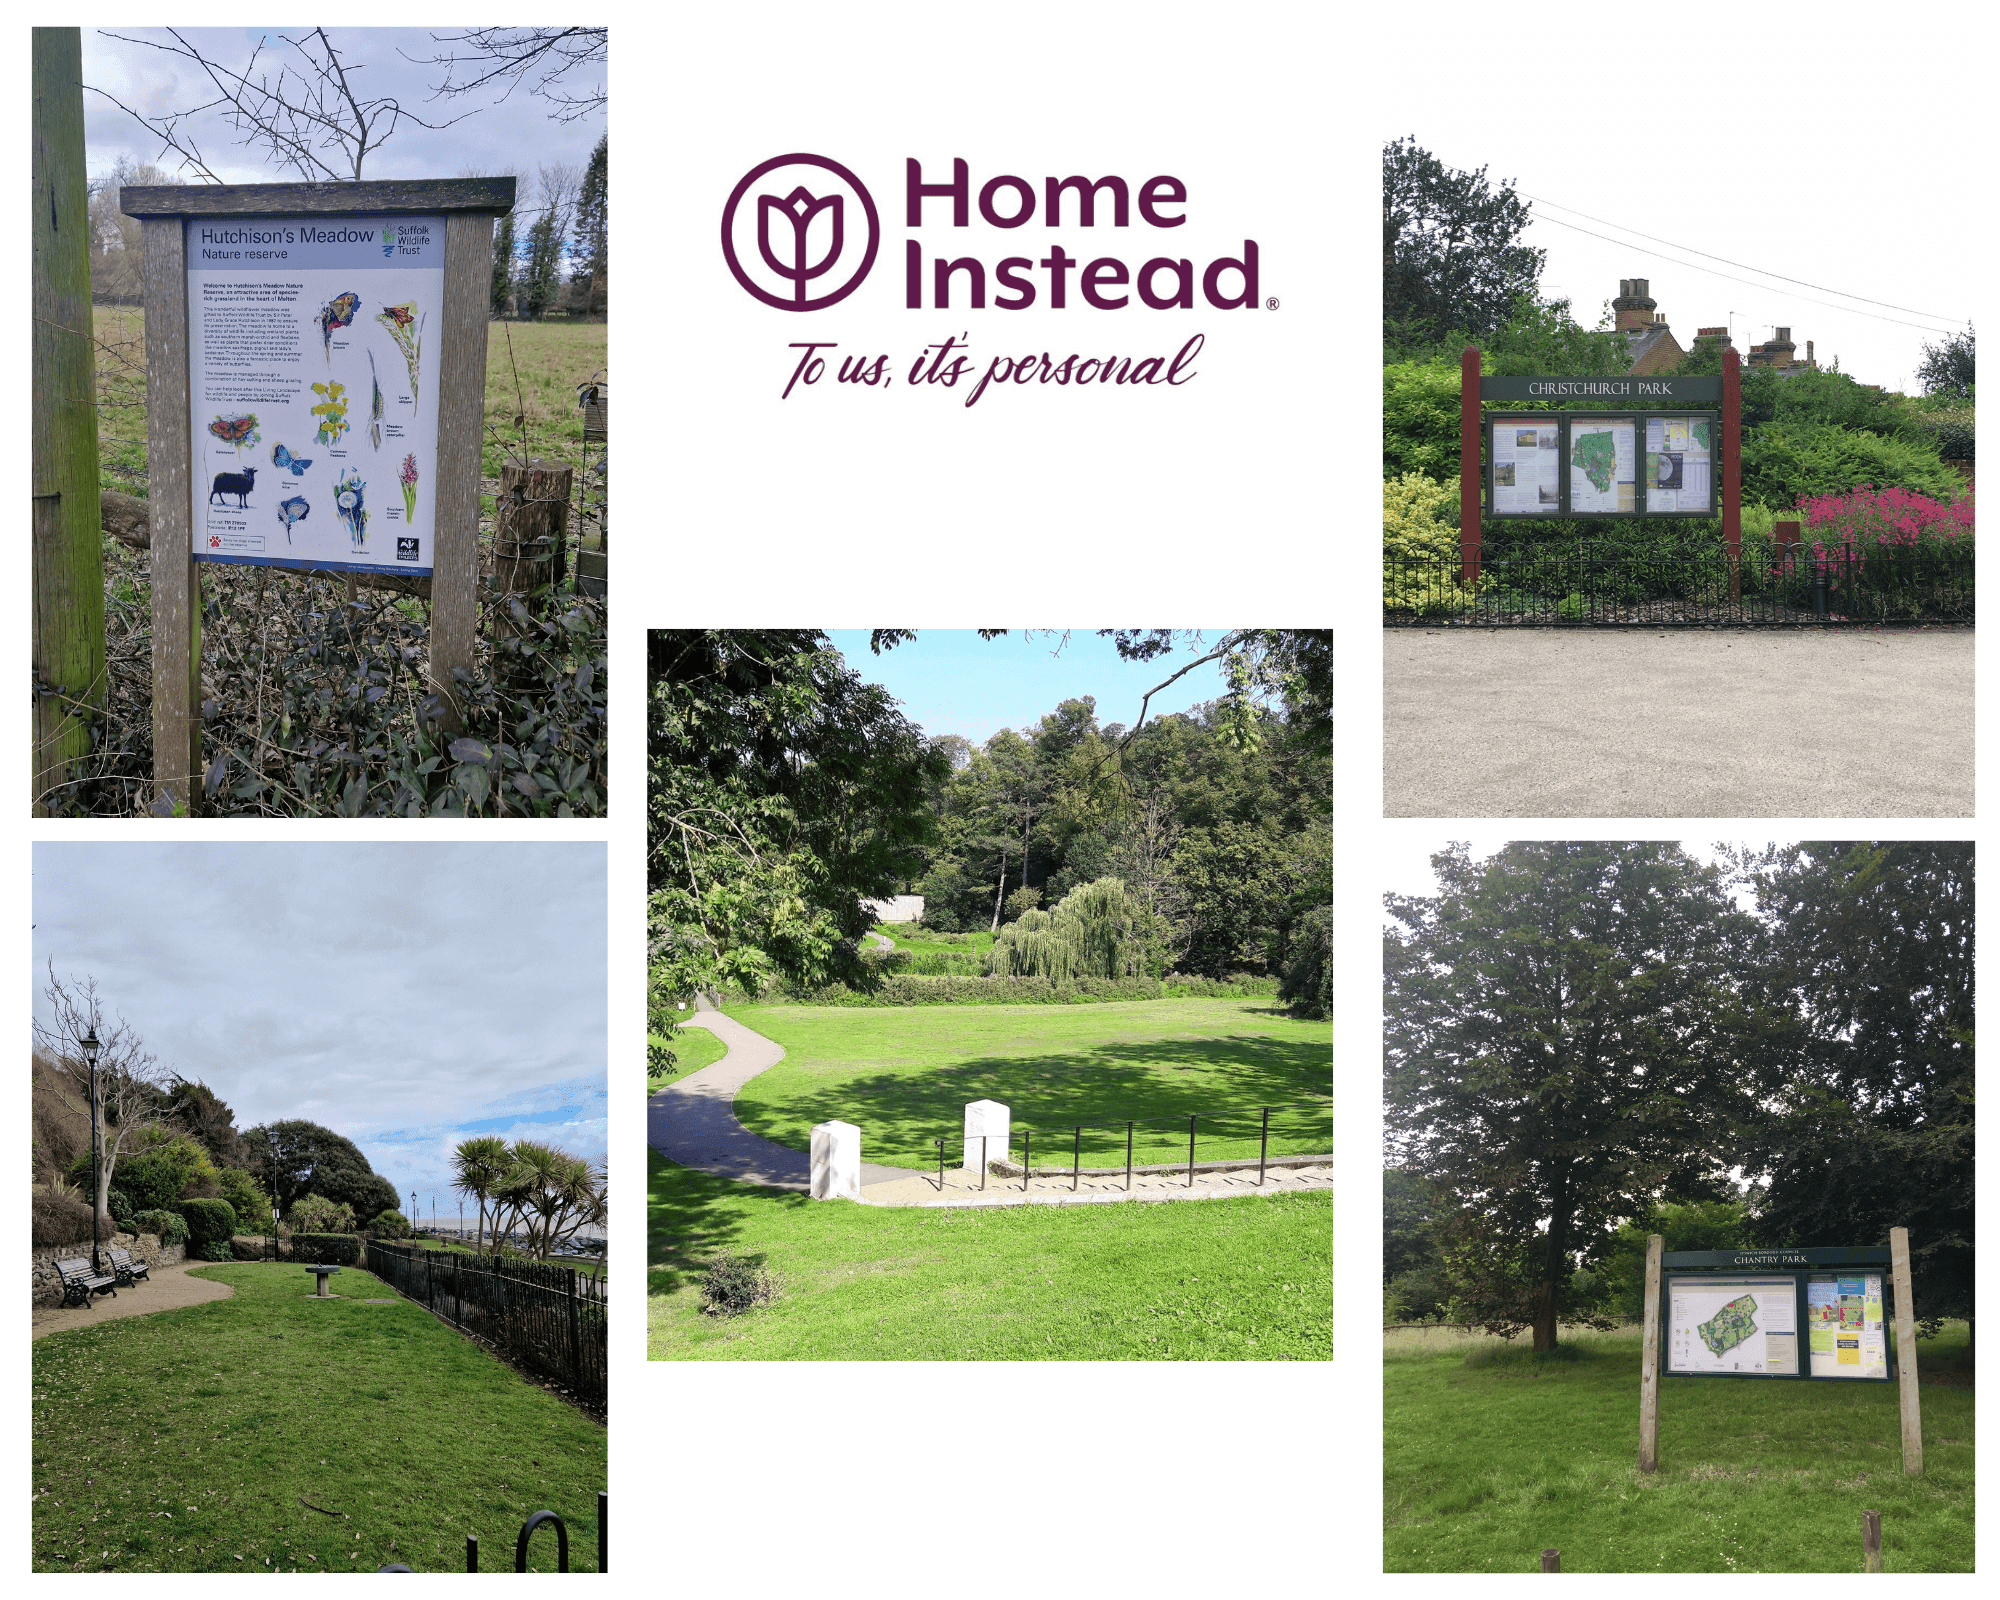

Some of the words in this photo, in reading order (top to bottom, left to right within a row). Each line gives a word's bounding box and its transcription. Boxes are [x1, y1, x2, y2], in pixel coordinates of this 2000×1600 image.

[202, 227, 294, 244] Hutchison's
[300, 226, 374, 243] Meadow
[398, 225, 429, 235] Suffolk
[398, 236, 430, 245] Wildlife
[202, 248, 241, 259] Nature
[245, 250, 288, 259] reserve
[398, 246, 420, 254] Trust
[1528, 382, 1630, 395] CHRISTCHURCH
[1638, 382, 1672, 395] PARK
[1734, 1256, 1778, 1264] CHANTRY
